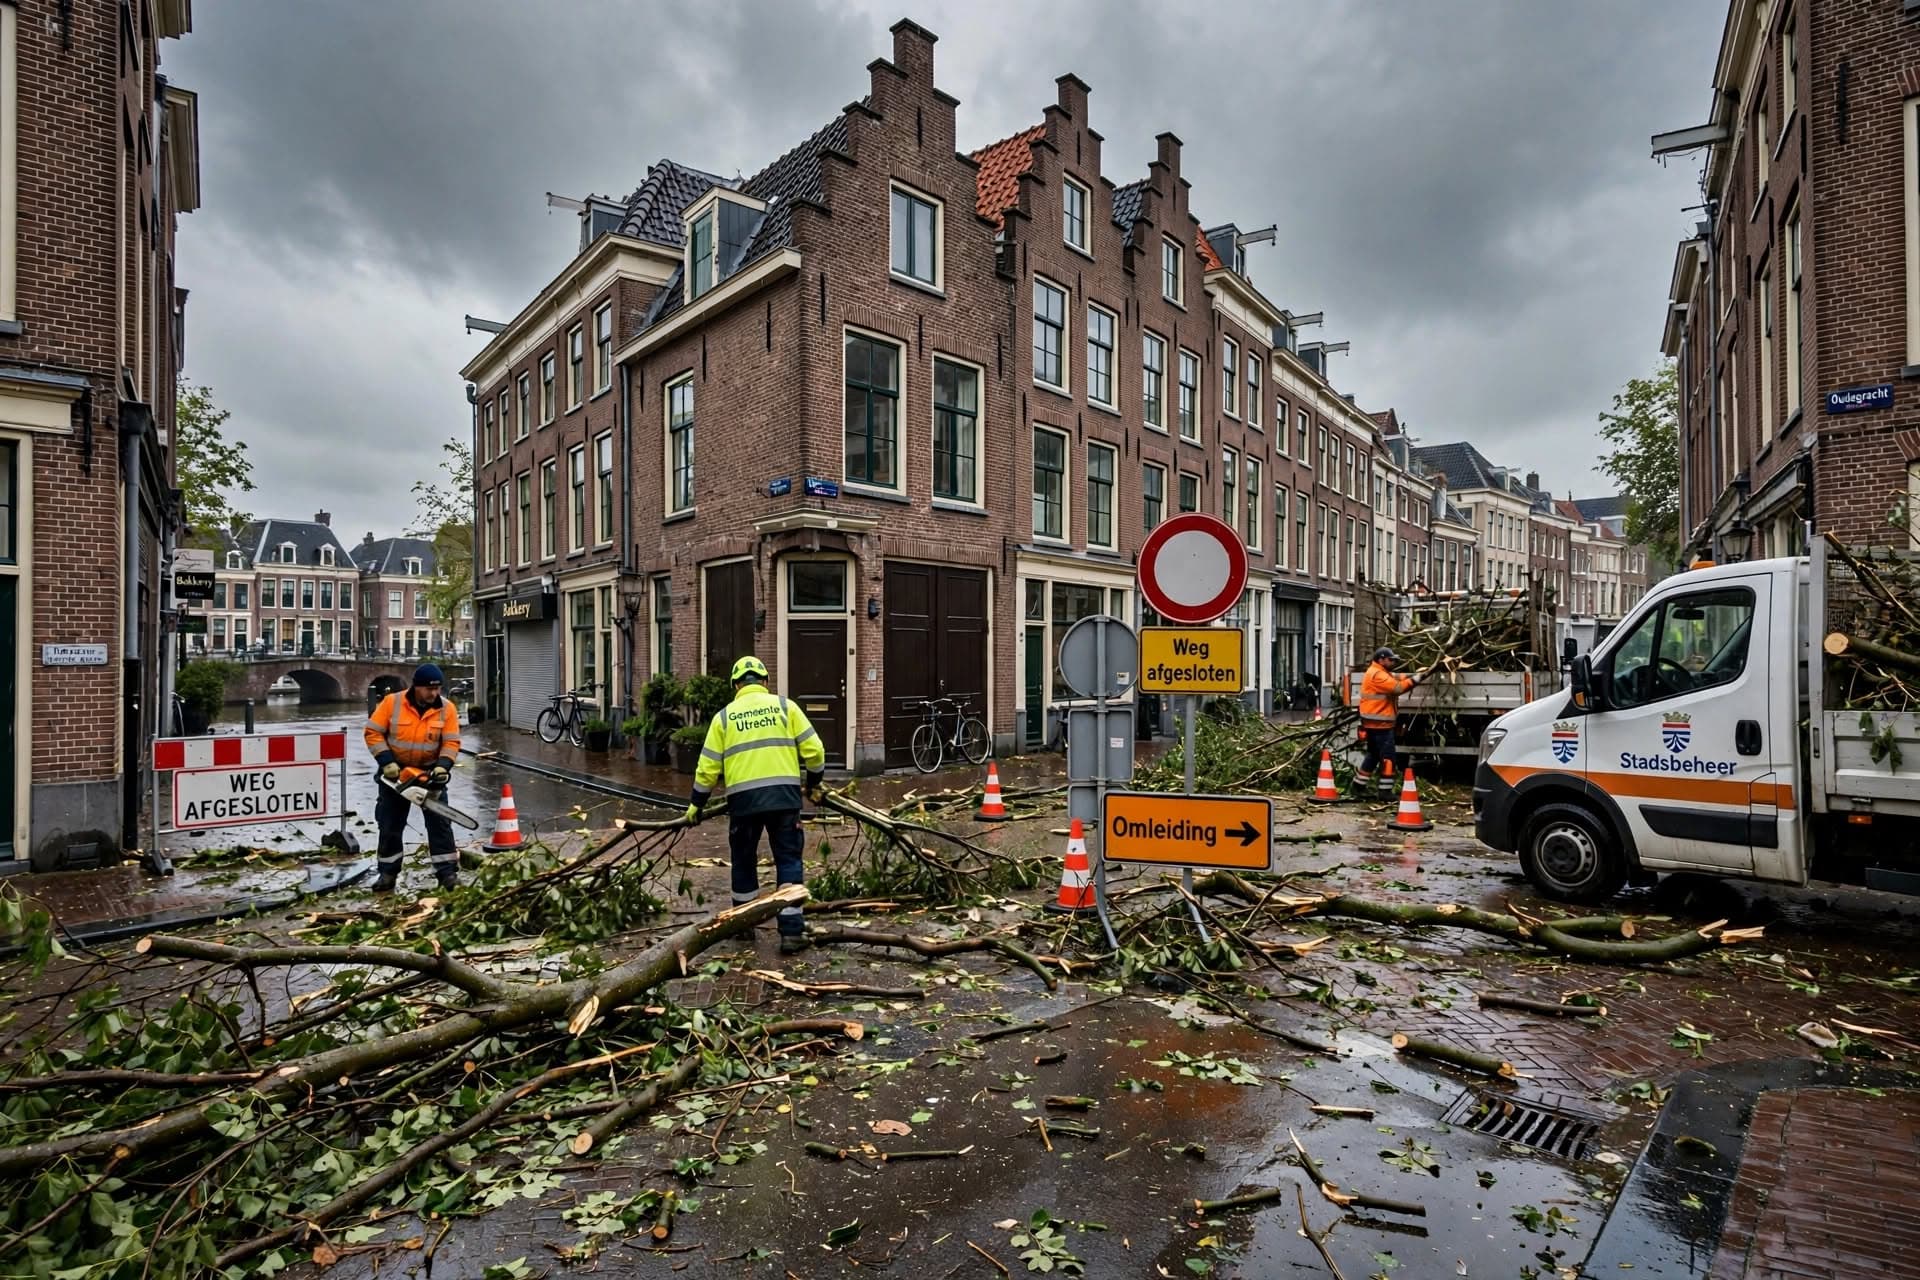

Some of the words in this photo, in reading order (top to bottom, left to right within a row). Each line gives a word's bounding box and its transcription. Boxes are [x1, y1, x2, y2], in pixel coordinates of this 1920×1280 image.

[1831, 388, 1888, 404] Oudegracht
[503, 601, 531, 618] Bakkery
[1173, 639, 1209, 659] Weg
[1147, 664, 1235, 685] afgesloten
[729, 706, 780, 721] Gemeente
[736, 717, 777, 732] Utrecht
[1620, 752, 1737, 776] Stadsbeheer
[230, 773, 275, 793] WEG
[185, 793, 319, 820] AFGESLOTEN
[1112, 815, 1217, 847] Omleiding
